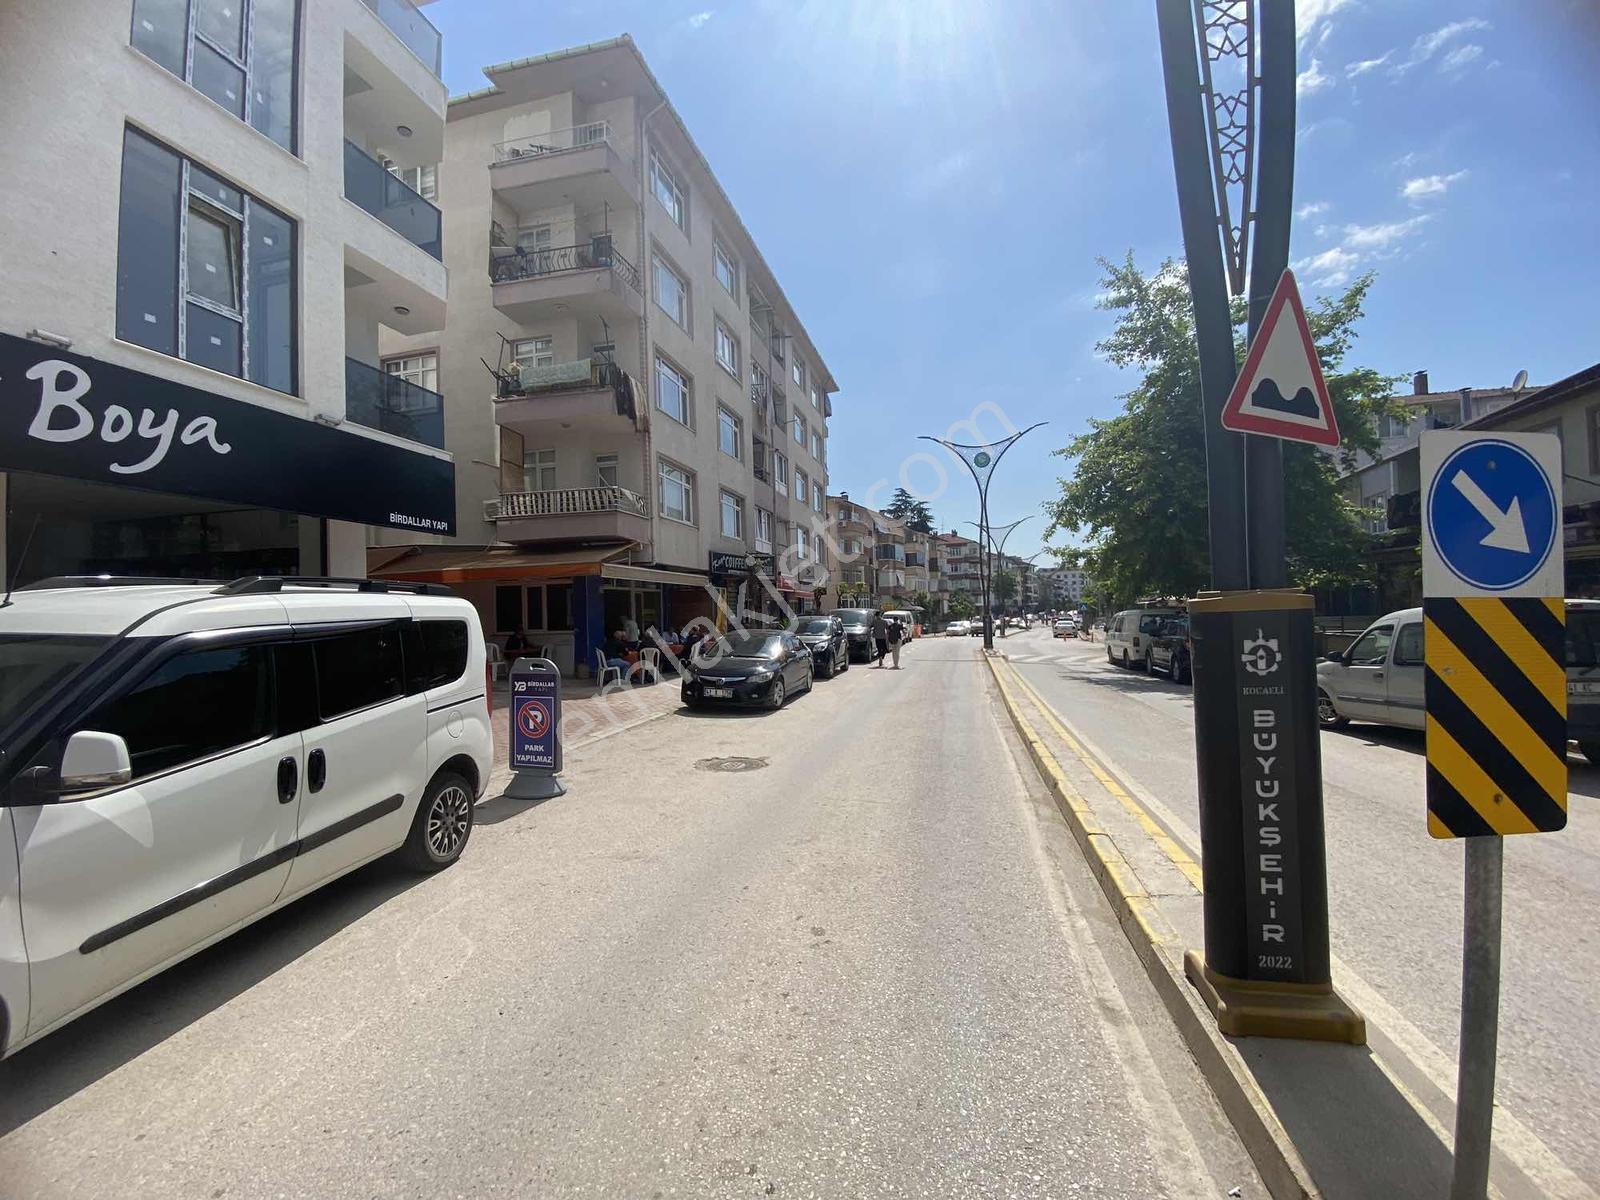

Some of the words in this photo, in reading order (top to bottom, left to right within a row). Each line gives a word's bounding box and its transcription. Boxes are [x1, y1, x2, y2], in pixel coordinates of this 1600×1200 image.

[26, 359, 232, 474] Boya
[389, 511, 431, 529] BİRDALLAR
[432, 520, 448, 531] YAPI
[524, 744, 545, 752] PARK
[516, 754, 553, 763] YAPILMAZ
[1253, 709, 1286, 943] BÜYÜKŞEHİR
[1258, 955, 1293, 969] 2022
